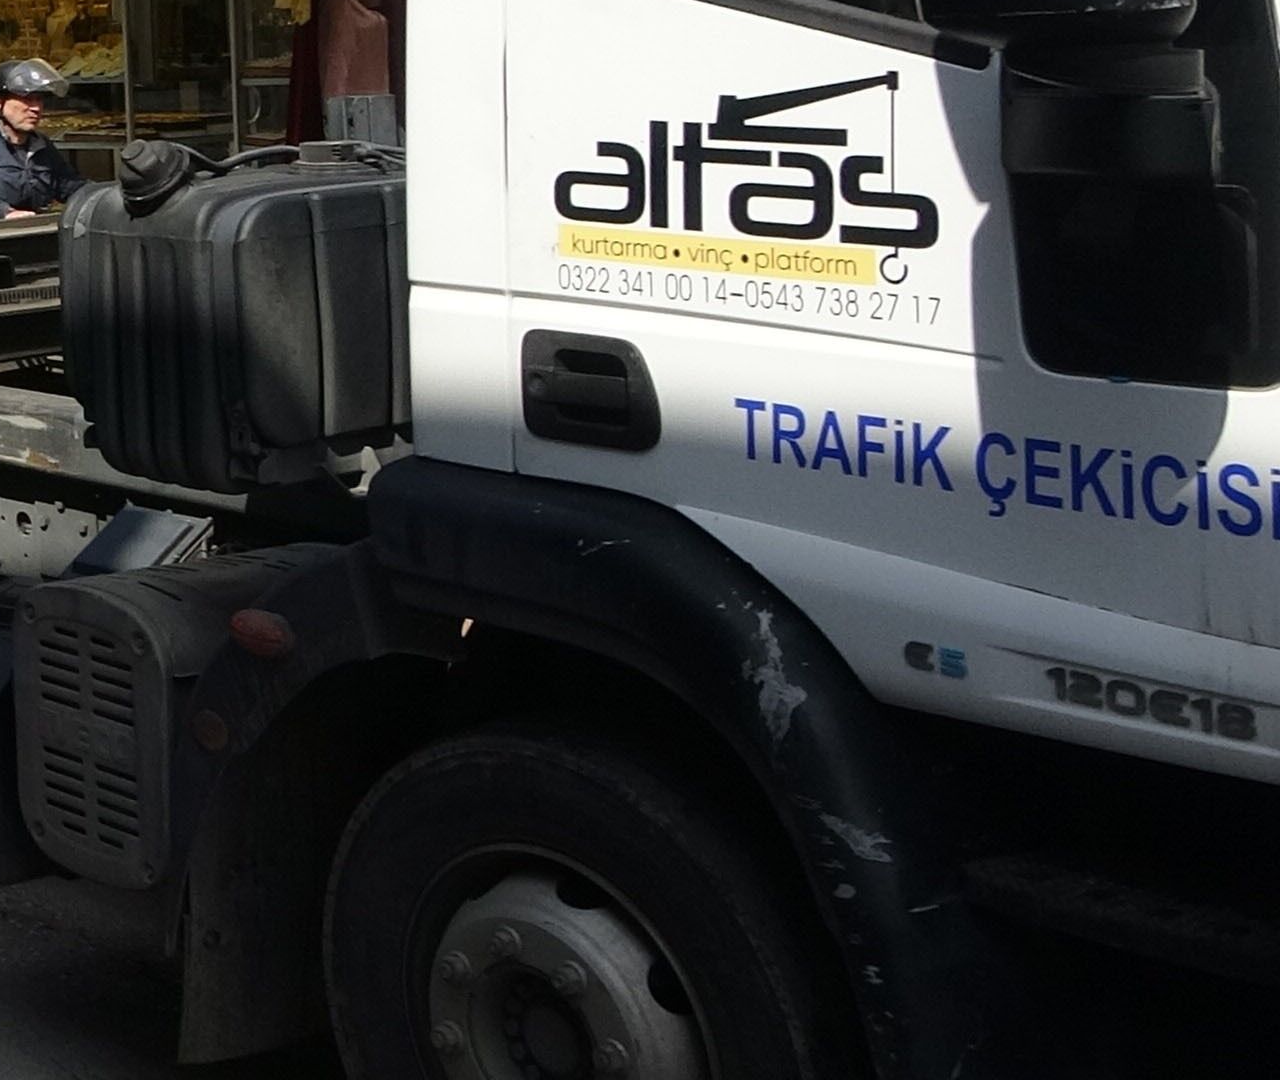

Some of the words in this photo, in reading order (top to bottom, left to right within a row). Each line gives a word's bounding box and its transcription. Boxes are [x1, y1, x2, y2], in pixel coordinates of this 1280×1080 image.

[571, 233, 668, 261] kurtarma
[688, 242, 734, 271] vinç
[753, 247, 858, 277] platform
[558, 264, 610, 294] 0322
[618, 270, 655, 297] 341
[665, 273, 693, 302] 00
[815, 287, 859, 318] 738
[870, 291, 899, 321] 27
[912, 295, 940, 325] 17
[735, 397, 953, 492] TRAFİK
[976, 431, 1280, 541] ÇEKİCİSİ
